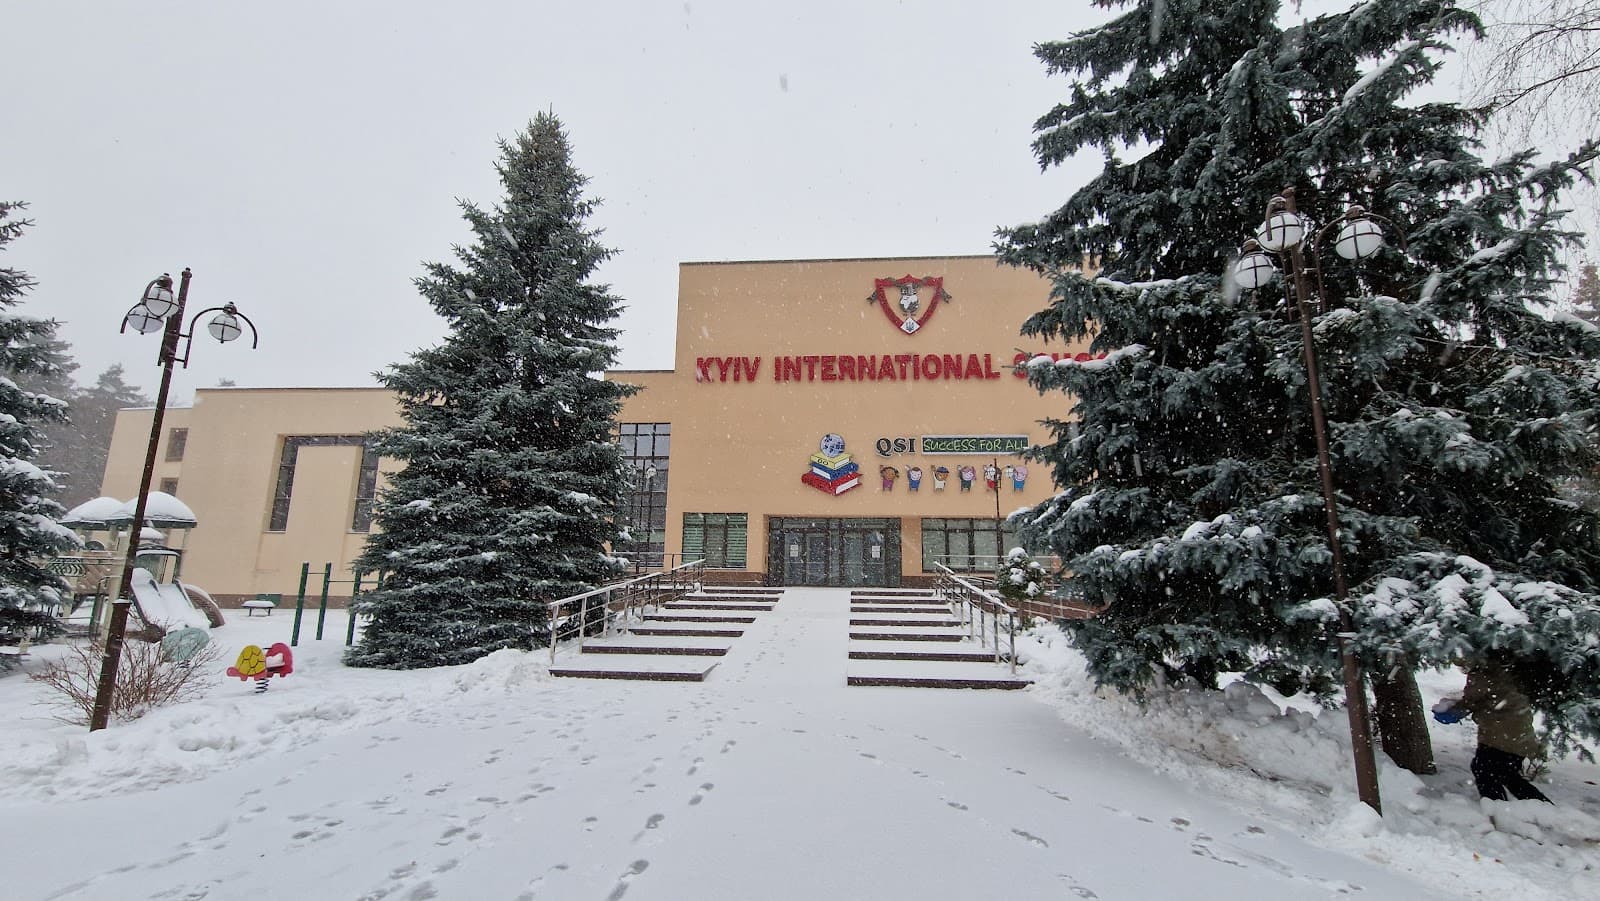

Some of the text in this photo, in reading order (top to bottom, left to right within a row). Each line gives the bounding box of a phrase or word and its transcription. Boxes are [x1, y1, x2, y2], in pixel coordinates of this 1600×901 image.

[696, 355, 761, 382] KYIV
[774, 353, 1001, 382] INTERNATIONAL
[875, 437, 916, 457] QSI
[923, 438, 1026, 451] SUCCESS FOR ALL
